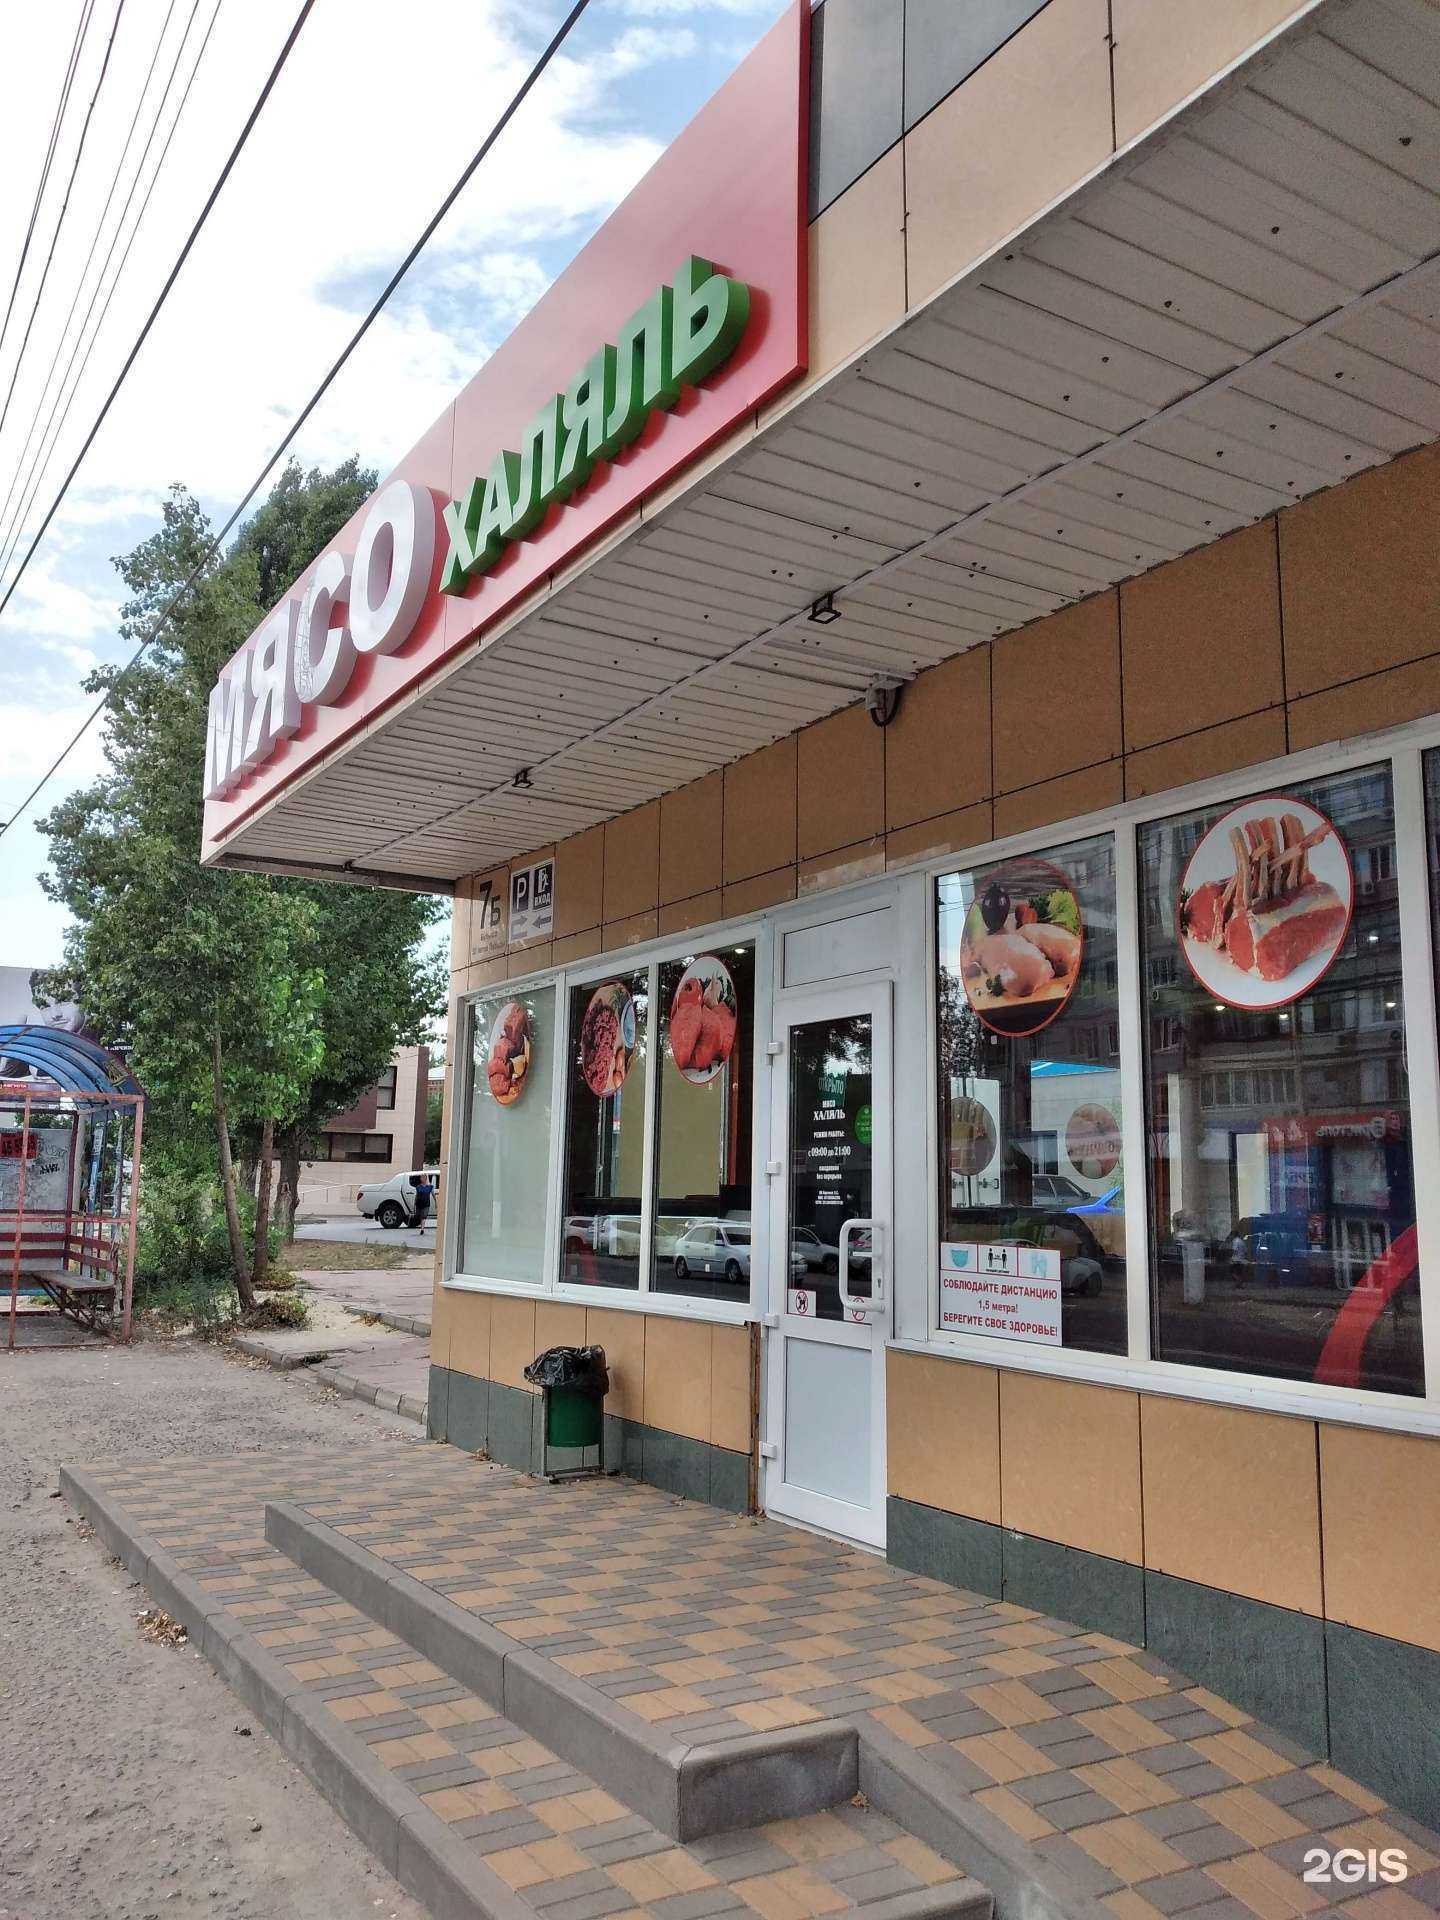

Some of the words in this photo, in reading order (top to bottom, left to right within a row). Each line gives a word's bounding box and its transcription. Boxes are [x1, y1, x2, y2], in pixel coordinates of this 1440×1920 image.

[440, 254, 750, 596] ХАЛЯЛЬ
[204, 479, 436, 801] МЯСО
[534, 893, 550, 907] ВХОД
[813, 1109, 845, 1120] ХАЛЯЛЬ
[811, 1147, 828, 1157] 09:00
[834, 1146, 850, 1156] 21:00
[943, 1278, 999, 1294] СОБЛЮДАЙТЕ
[1001, 1284, 1058, 1300] ДИСТАНЦИЮ
[978, 1299, 990, 1310] 1,5
[991, 1302, 1018, 1315] метра!
[943, 1311, 983, 1327] БЕРЕГИТЕ
[984, 1317, 1007, 1330] СВОЕ
[1009, 1320, 1058, 1337] ЗДОРОВЬЕ!
